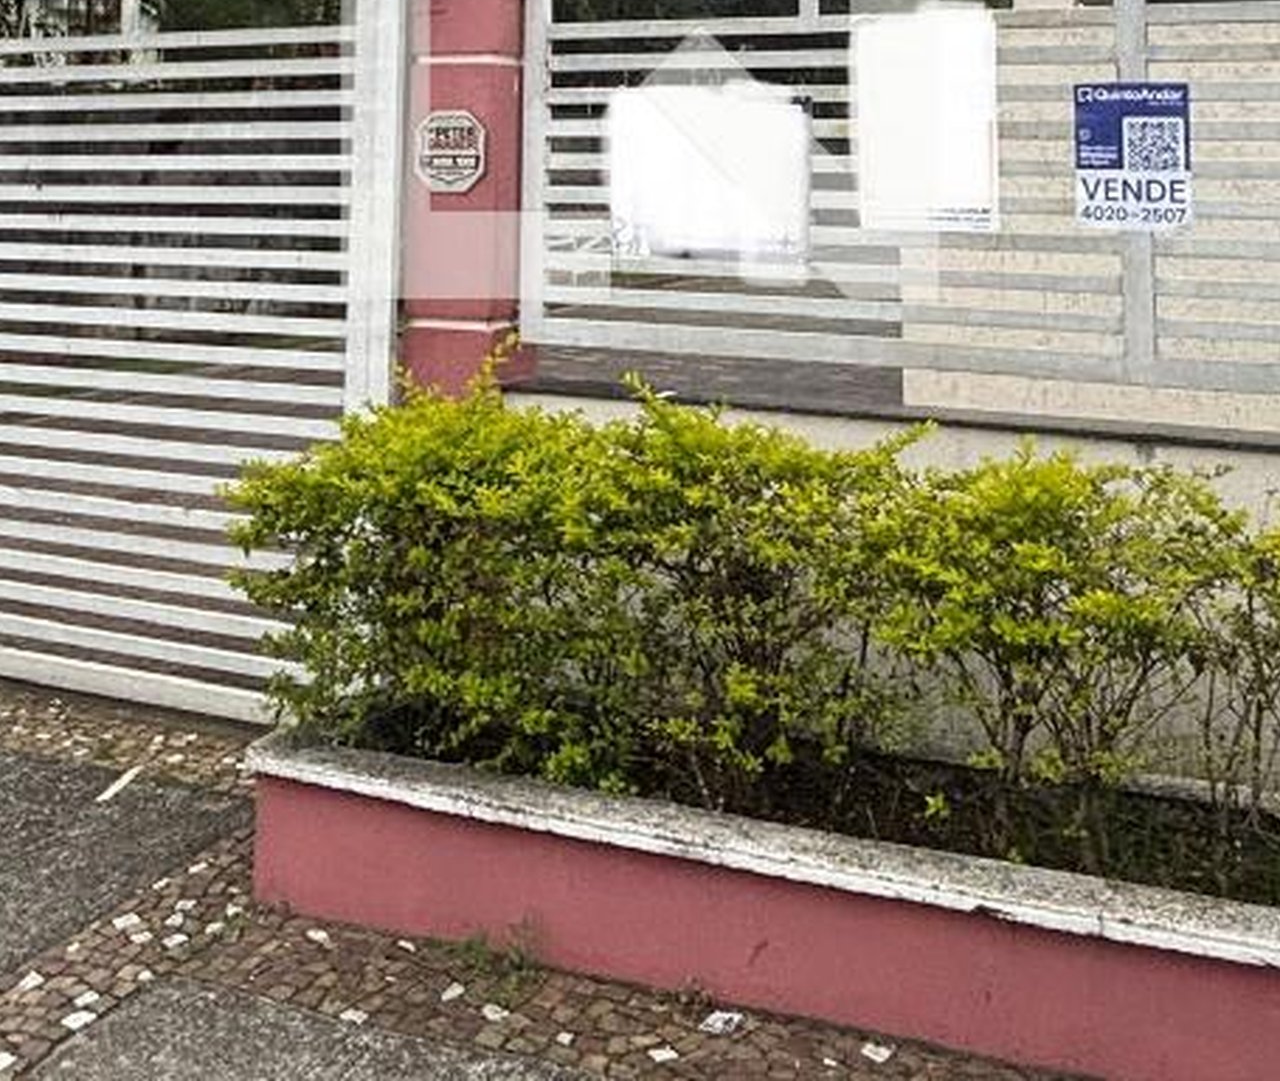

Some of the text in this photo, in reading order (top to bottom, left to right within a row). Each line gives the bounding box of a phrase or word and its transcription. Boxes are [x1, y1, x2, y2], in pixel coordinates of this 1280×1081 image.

[1094, 87, 1184, 101] QuintoAndar
[1081, 177, 1187, 204] VENDE
[1081, 205, 1187, 224] 4020-2507
